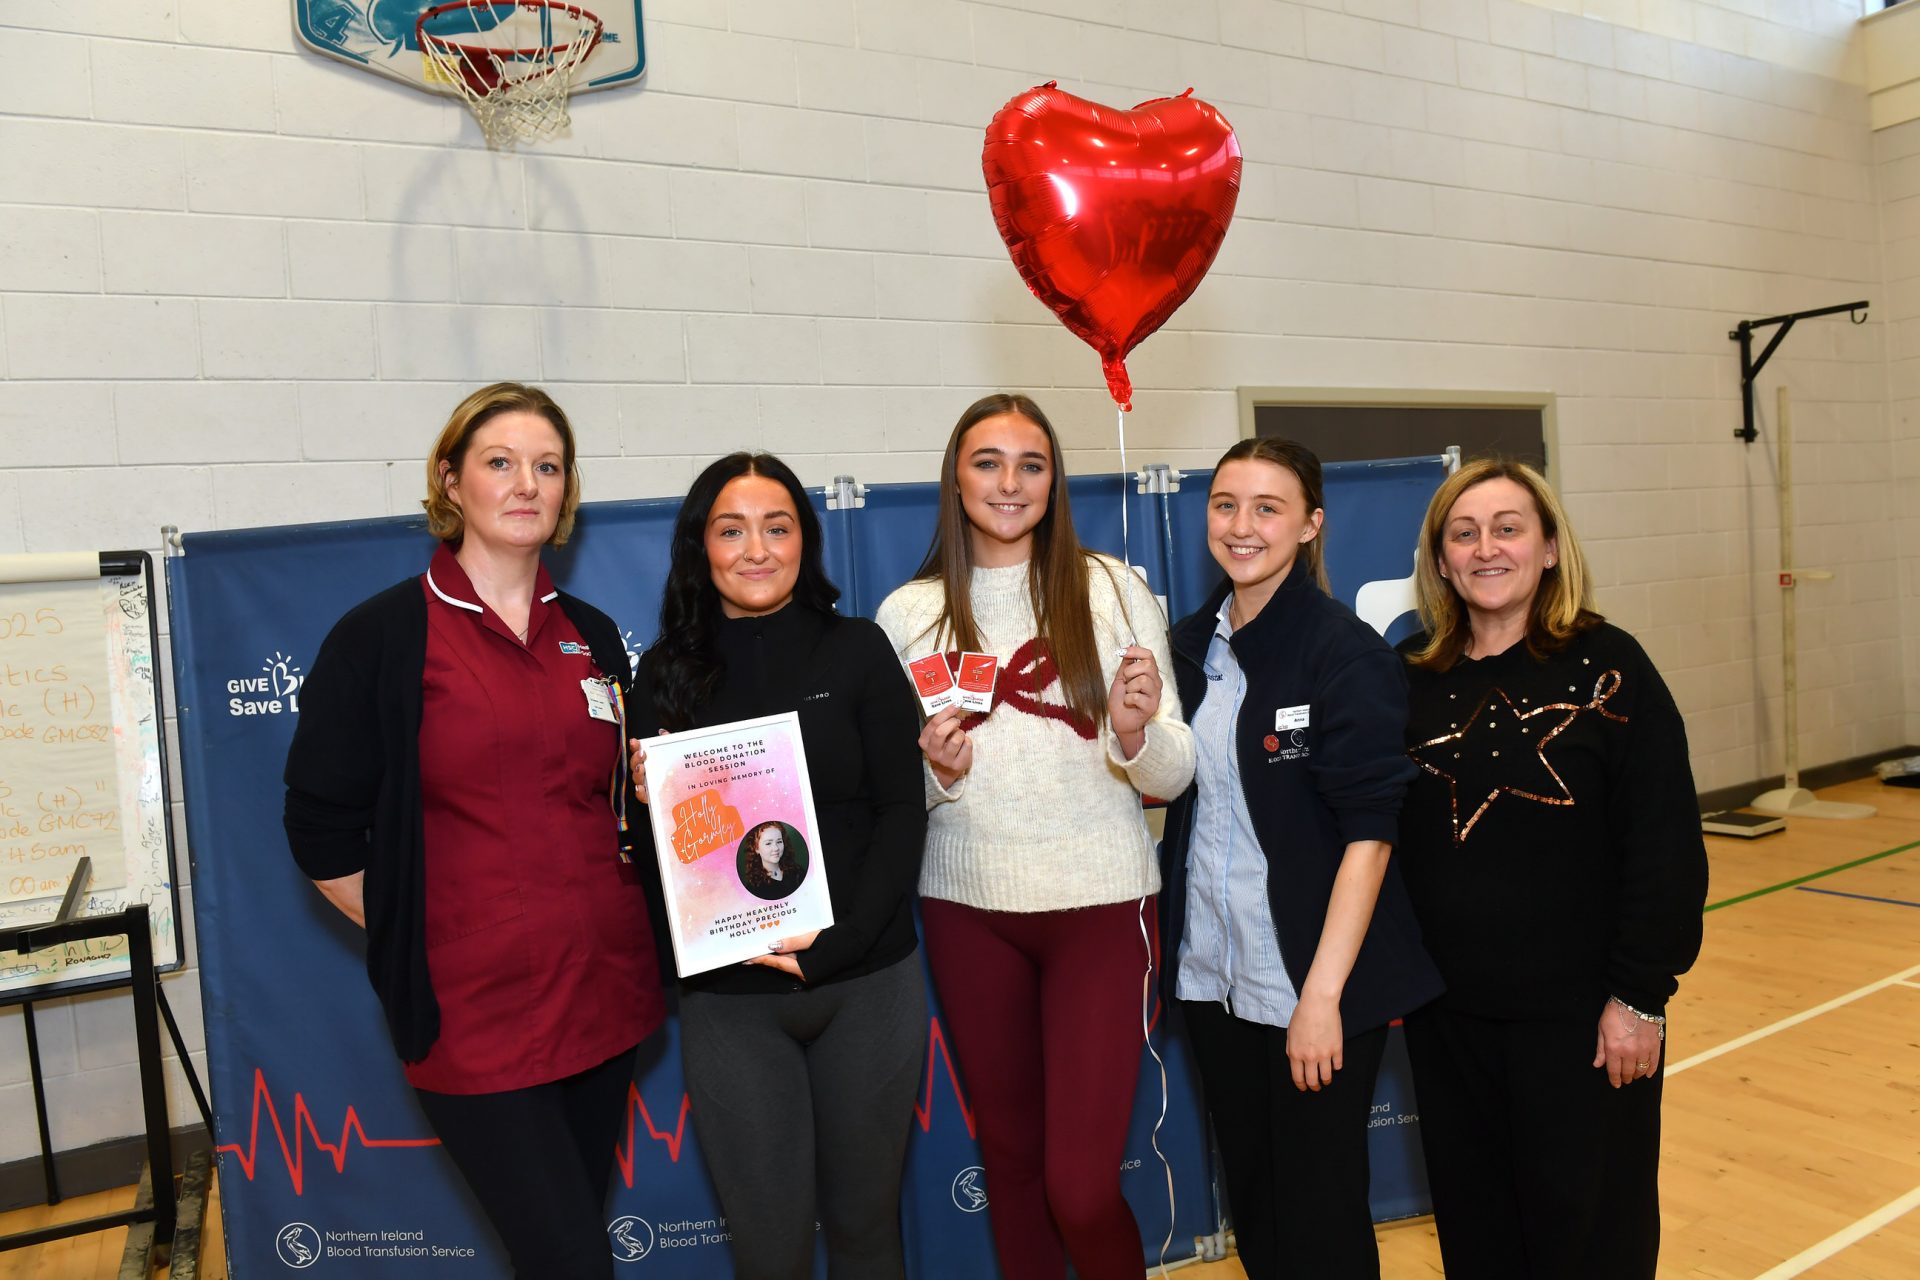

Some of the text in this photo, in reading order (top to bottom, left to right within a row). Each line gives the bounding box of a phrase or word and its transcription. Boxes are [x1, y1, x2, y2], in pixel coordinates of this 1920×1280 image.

[227, 677, 270, 694] GIVE
[229, 698, 283, 716] Save
[684, 739, 764, 760] WELCOME TO THE
[684, 747, 766, 769] BLOOD DONATION
[708, 760, 746, 773] SESSION
[699, 777, 728, 788] LOVING
[731, 771, 763, 782] MEMORY
[765, 767, 775, 775] OF
[677, 794, 718, 831] Holly
[709, 907, 797, 936] BIRTHDAY PRECIOUS
[714, 901, 789, 926] HAPPY HEAVENLY
[729, 926, 757, 939] HOLLY
[658, 1220, 717, 1233] Northern
[325, 1229, 424, 1242] Northern Ireland
[659, 1234, 698, 1249] Blood
[326, 1245, 475, 1258] Blood Transfusion Service
